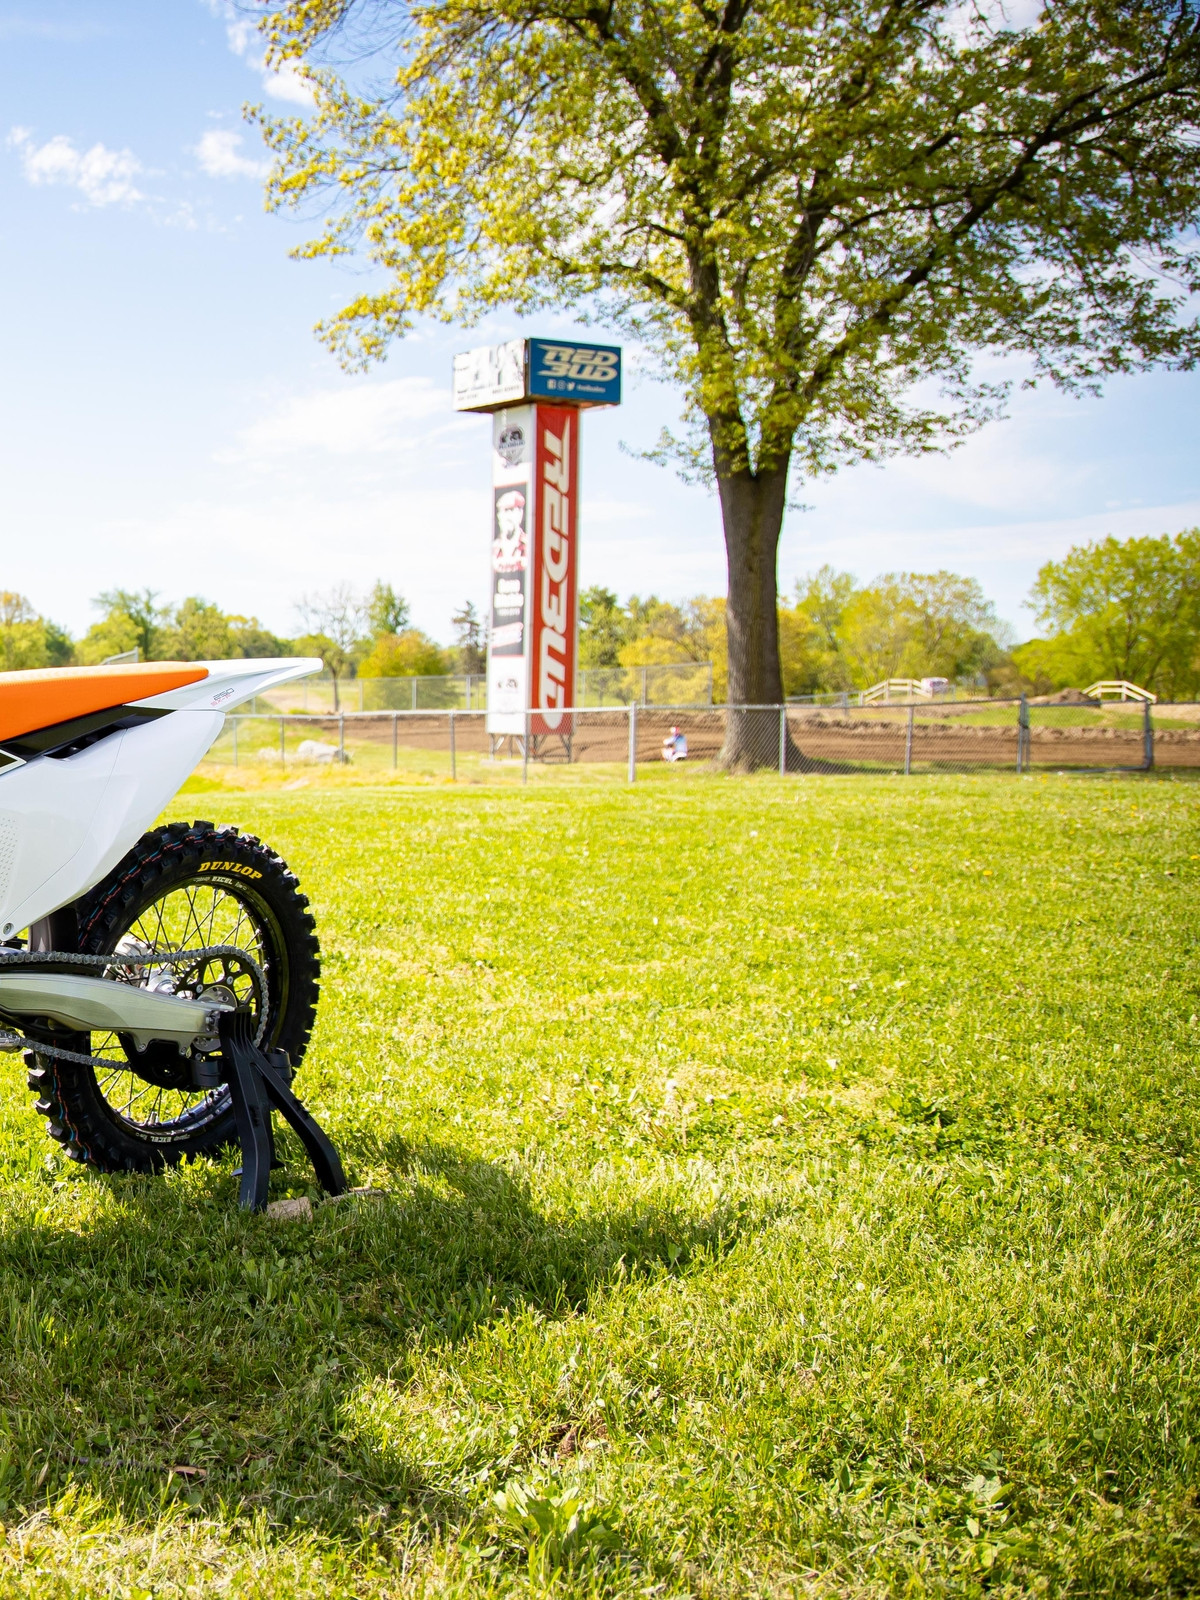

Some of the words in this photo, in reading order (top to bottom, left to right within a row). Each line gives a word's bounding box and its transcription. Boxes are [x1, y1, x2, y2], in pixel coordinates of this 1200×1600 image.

[537, 343, 619, 366] RED
[537, 362, 618, 382] BUD
[197, 861, 263, 880] DUNLOP
[211, 876, 233, 885] EXCEL
